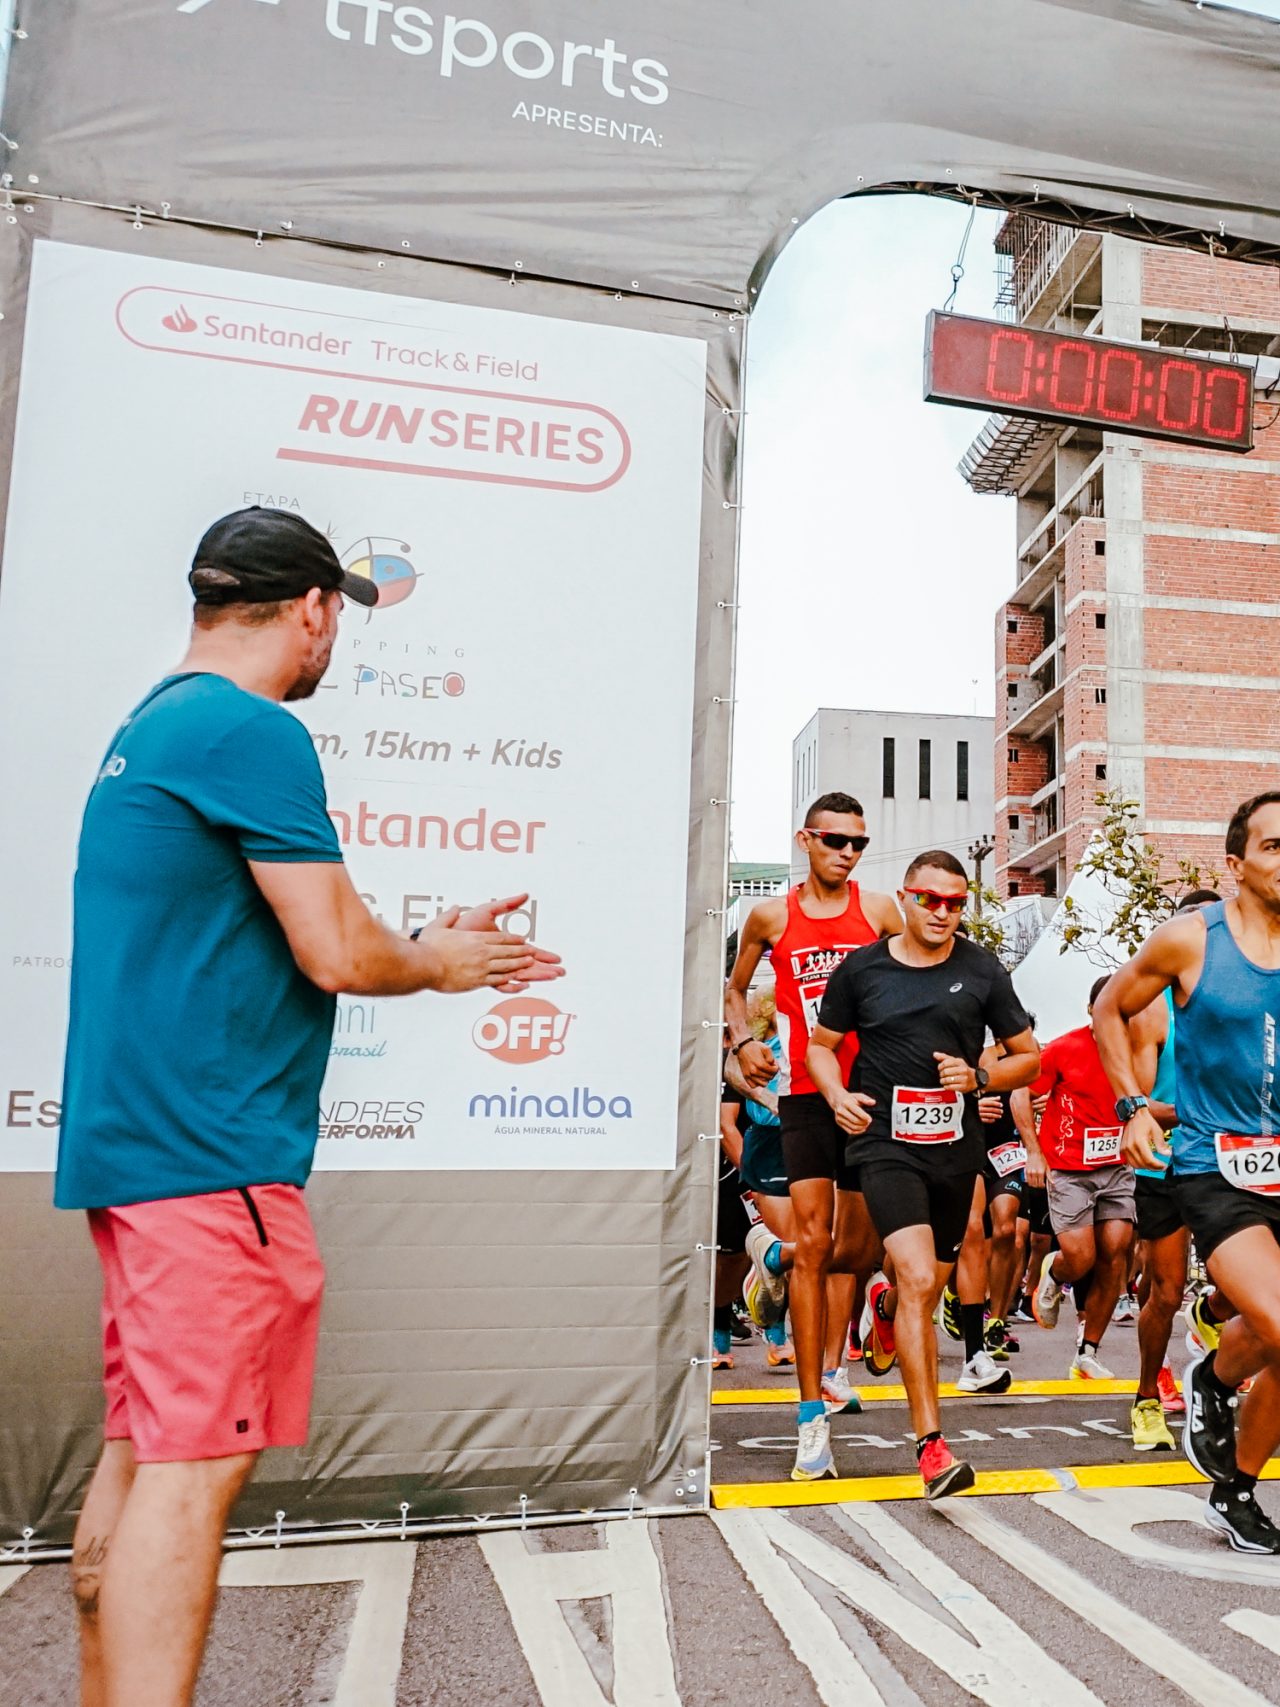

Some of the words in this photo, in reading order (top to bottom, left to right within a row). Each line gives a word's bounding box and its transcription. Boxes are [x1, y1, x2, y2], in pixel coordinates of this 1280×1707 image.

[512, 101, 664, 148] APRESENTA:
[204, 313, 353, 357] Santander
[987, 330, 1249, 440] 0:00:00
[243, 491, 301, 510] ETAPA
[354, 639, 465, 658] PPING
[354, 663, 466, 699] PASEO
[364, 730, 452, 762] 15km
[491, 739, 563, 769] Kids
[327, 801, 546, 854] ntander
[472, 1013, 572, 1056] OFF!
[6, 1090, 62, 1129] Es
[319, 1101, 425, 1124] NDRES
[468, 1085, 633, 1119] minalba
[900, 1106, 953, 1125] 1239
[318, 1124, 416, 1141] ERFORMA
[494, 1124, 521, 1135] ÁGUA
[522, 1126, 563, 1135] MINERAL
[565, 1126, 608, 1136] NATURAL
[1089, 1138, 1118, 1152] 1255
[1191, 1391, 1205, 1434] FILA
